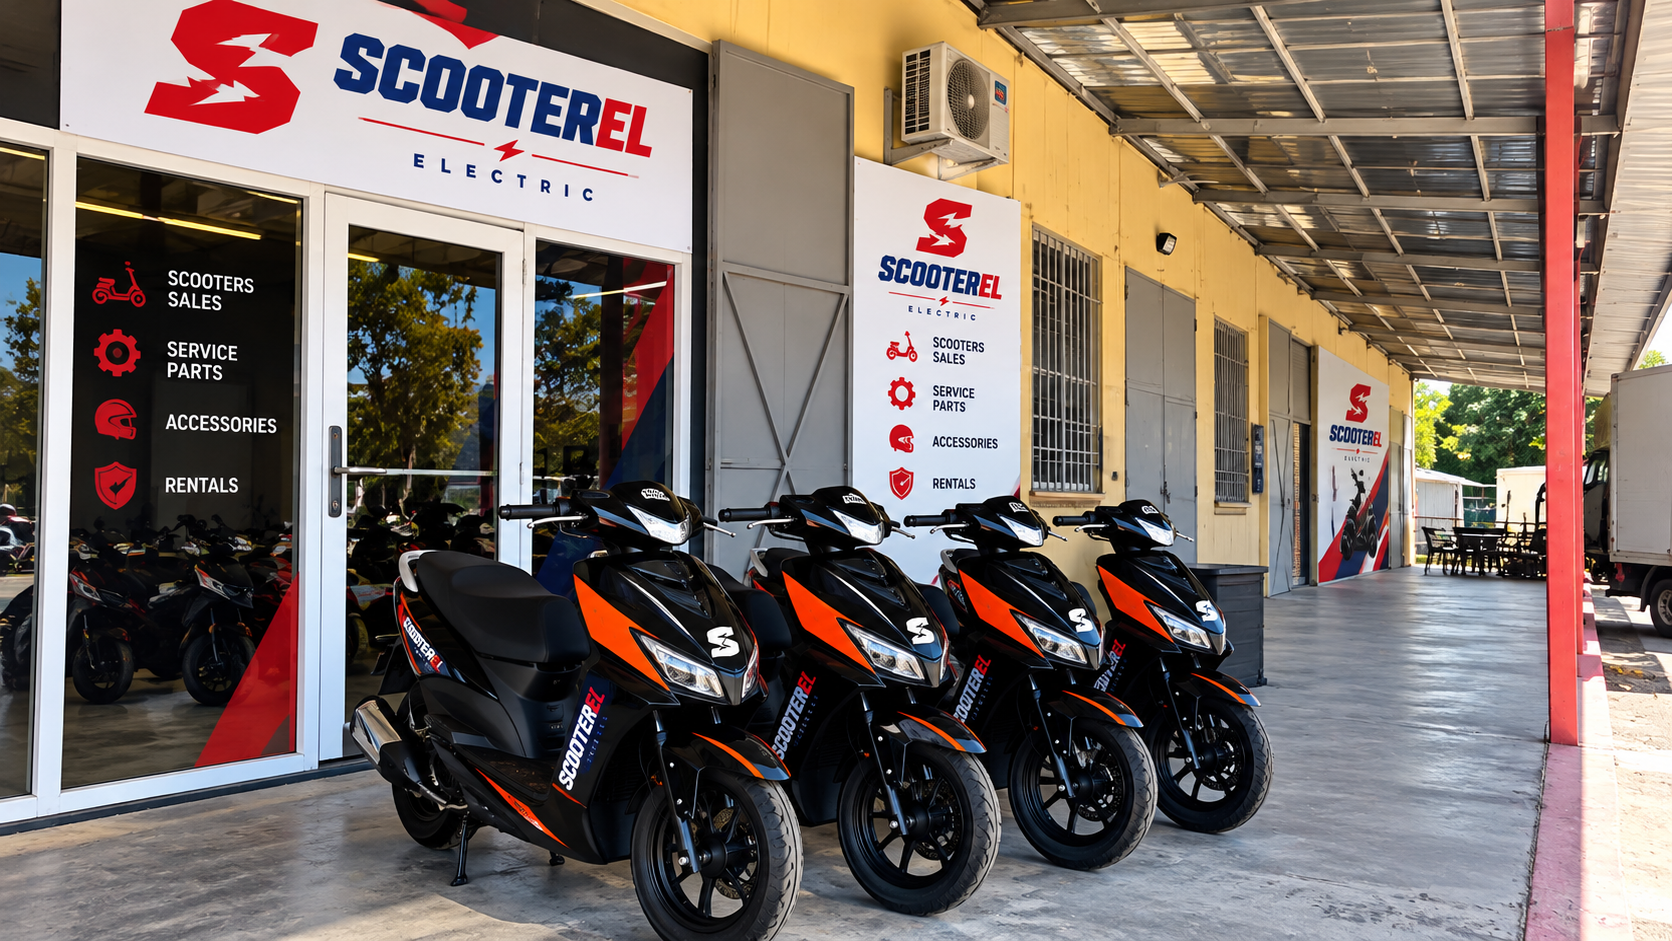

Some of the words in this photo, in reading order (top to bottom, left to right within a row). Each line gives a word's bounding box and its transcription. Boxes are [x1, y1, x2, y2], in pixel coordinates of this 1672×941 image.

[333, 32, 652, 158] SCOOTEREL
[413, 153, 594, 202] ELECTRIC
[167, 269, 254, 294] SCOOTERS
[877, 255, 1002, 300] SCOOTEREL
[167, 291, 222, 311] SALES
[908, 305, 976, 321] ELECTRIC
[167, 341, 238, 361] SERVICE
[932, 336, 985, 353] SCOOTERS
[932, 351, 966, 365] SALES
[167, 362, 223, 381] PARTS
[932, 385, 975, 399] SERVICE
[932, 400, 966, 413] PARTS
[165, 414, 277, 434] ACCESSORIES
[932, 436, 998, 449] ACCESSORIES
[1328, 424, 1382, 448] SCOOTEREL
[165, 477, 239, 494] RENTALS
[932, 478, 976, 490] RENTALS
[558, 686, 606, 791] SCOOTEREL
